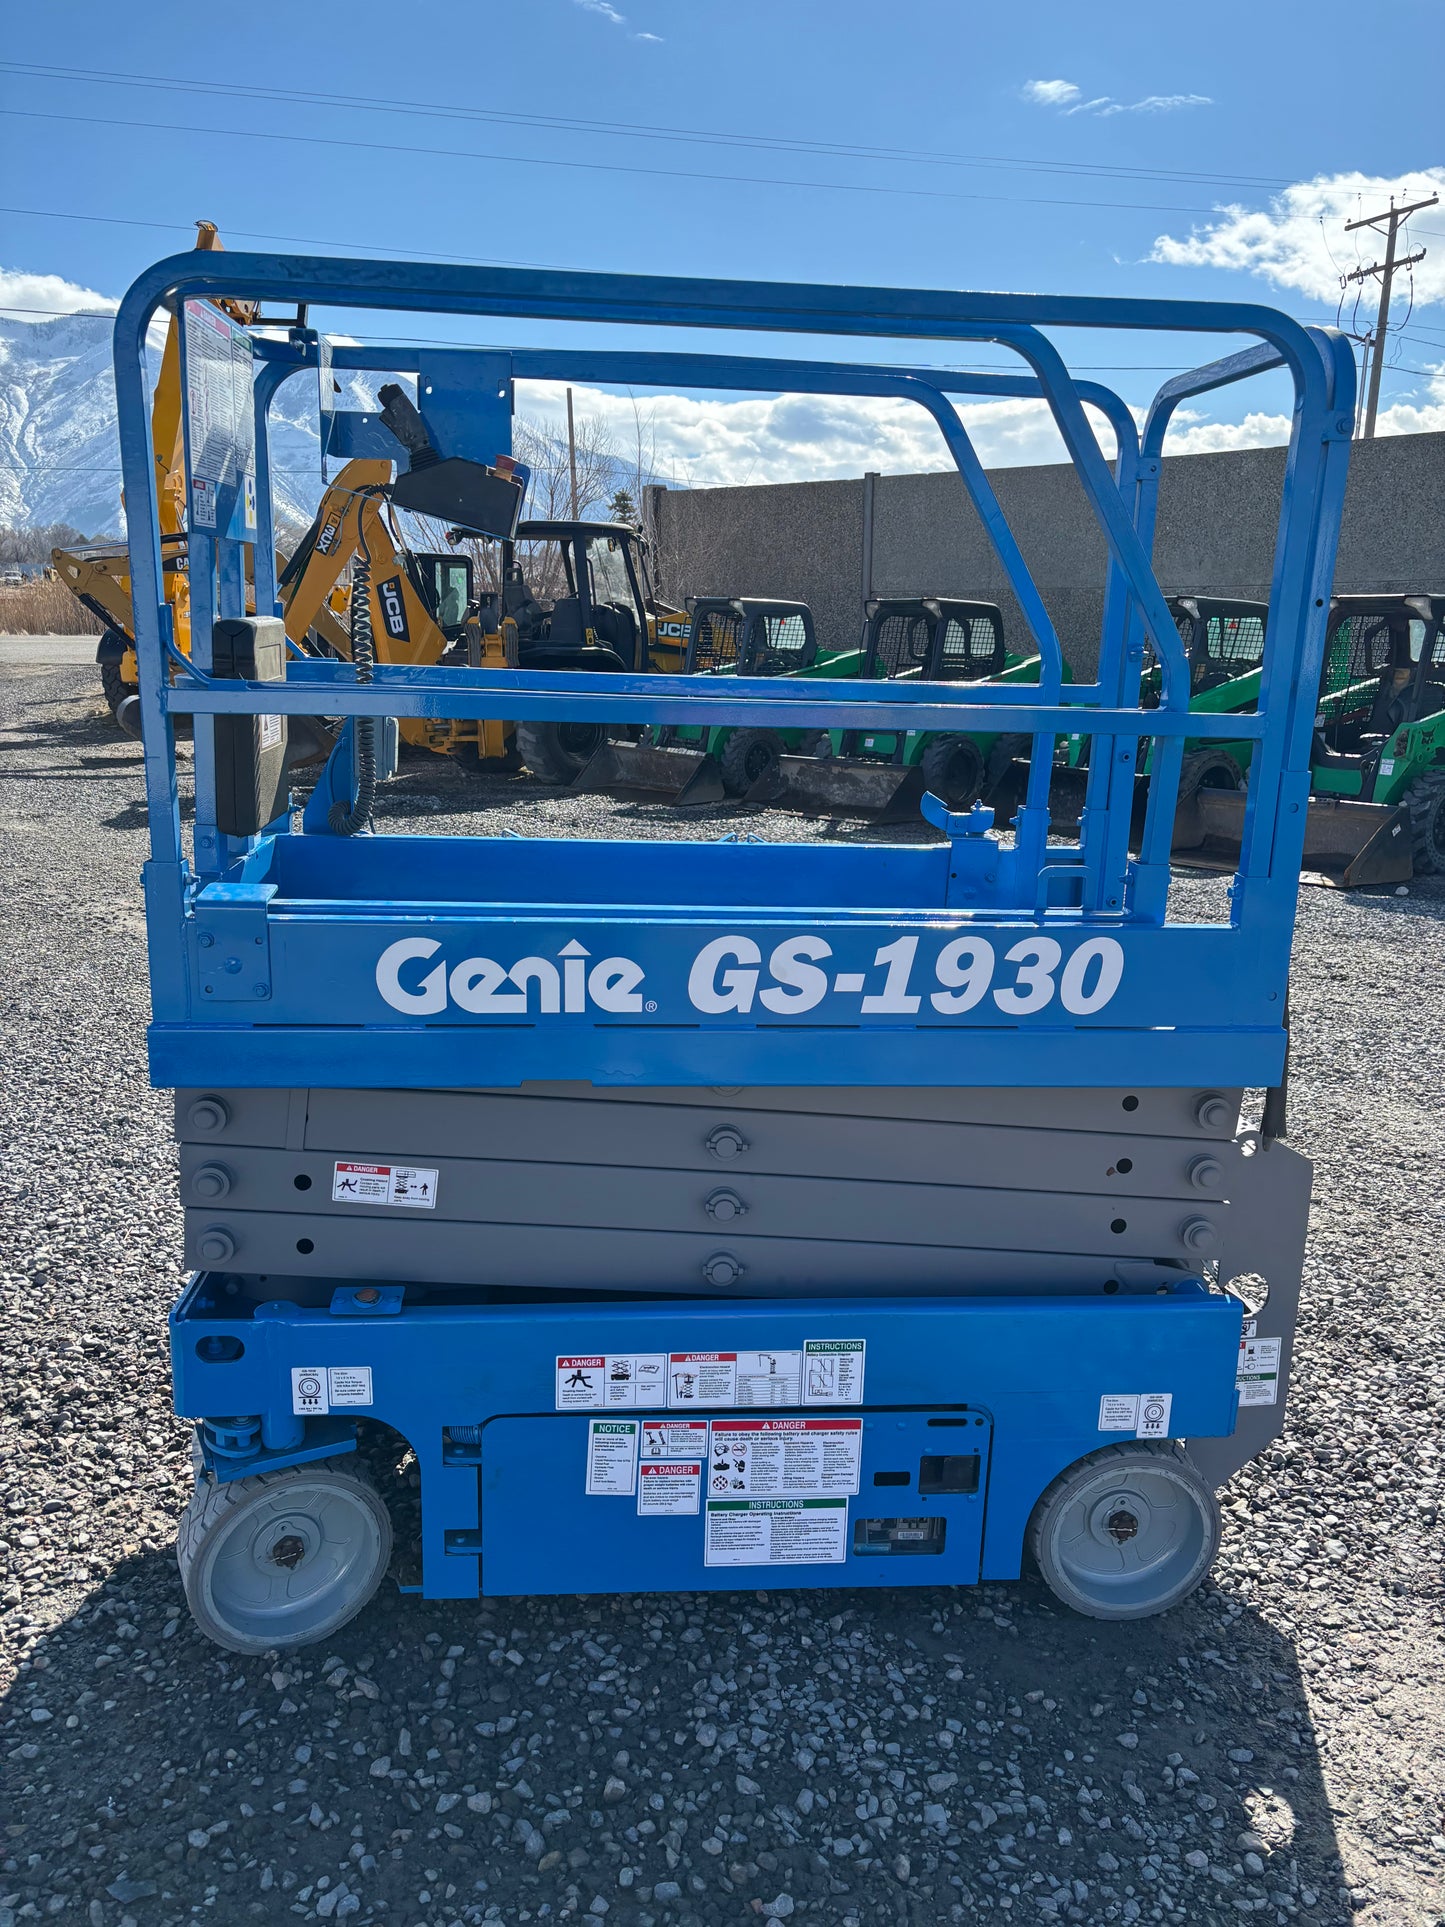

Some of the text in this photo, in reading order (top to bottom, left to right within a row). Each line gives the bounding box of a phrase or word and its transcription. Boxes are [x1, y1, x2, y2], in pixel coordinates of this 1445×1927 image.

[382, 582, 404, 634] JCB
[657, 622, 692, 638] JCB
[375, 934, 1124, 1016] Genie GS-1930
[353, 1164, 378, 1174] DANGER
[808, 1342, 863, 1351] INSTRUCTIONS
[571, 1359, 602, 1367] DANGER
[599, 1424, 631, 1433] NOTICE
[772, 1422, 806, 1430] DANGER
[658, 1466, 693, 1474] DANGER
[748, 1500, 804, 1510] INSTRUCTIONS
